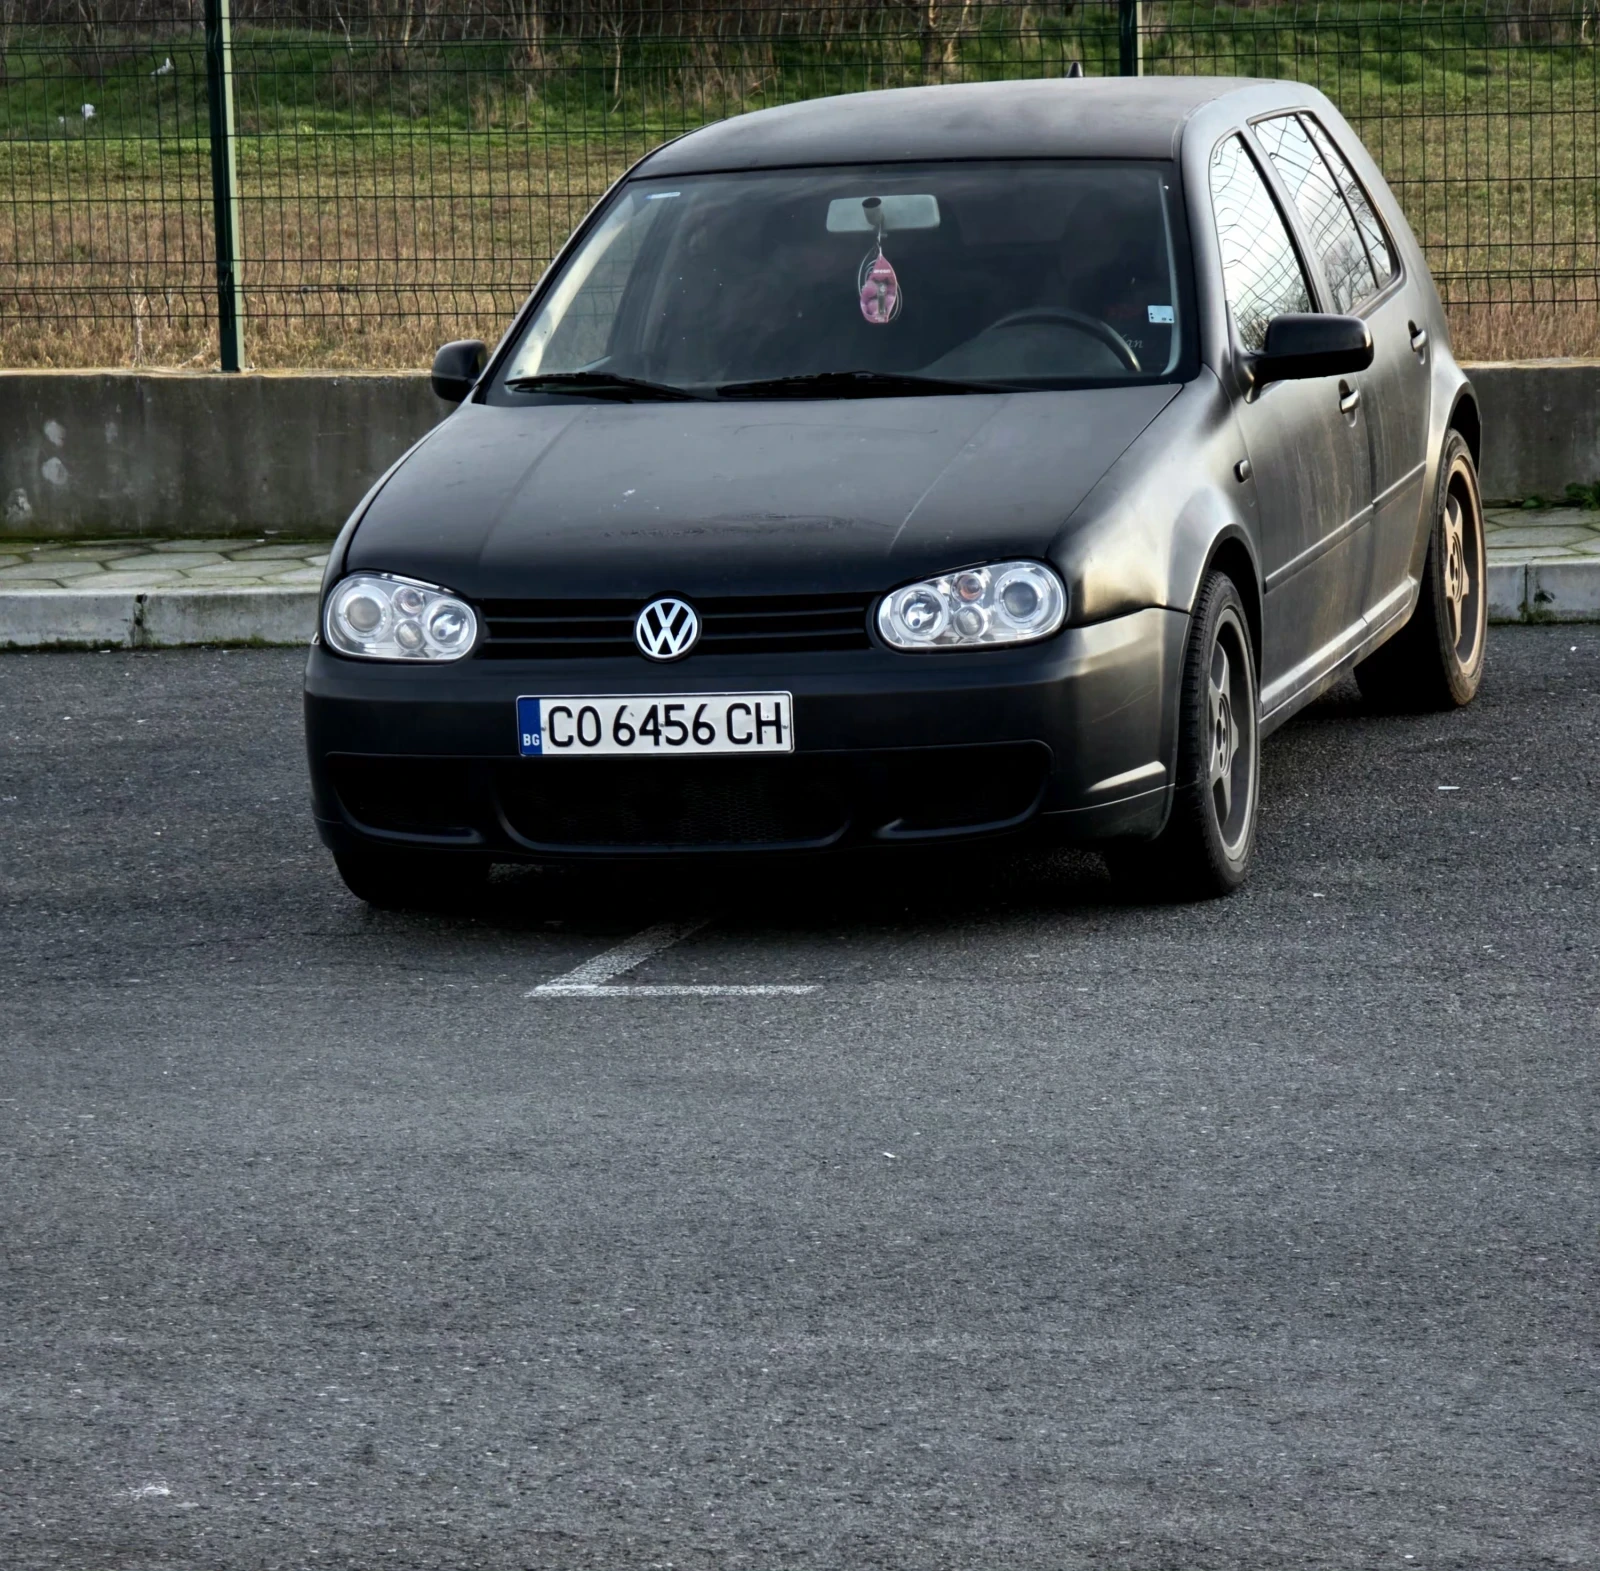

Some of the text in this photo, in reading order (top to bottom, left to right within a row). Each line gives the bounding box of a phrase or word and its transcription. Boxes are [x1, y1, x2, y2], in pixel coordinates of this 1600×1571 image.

[636, 598, 698, 659] VW
[523, 733, 540, 746] BG
[548, 702, 783, 748] CO 6456 CH
